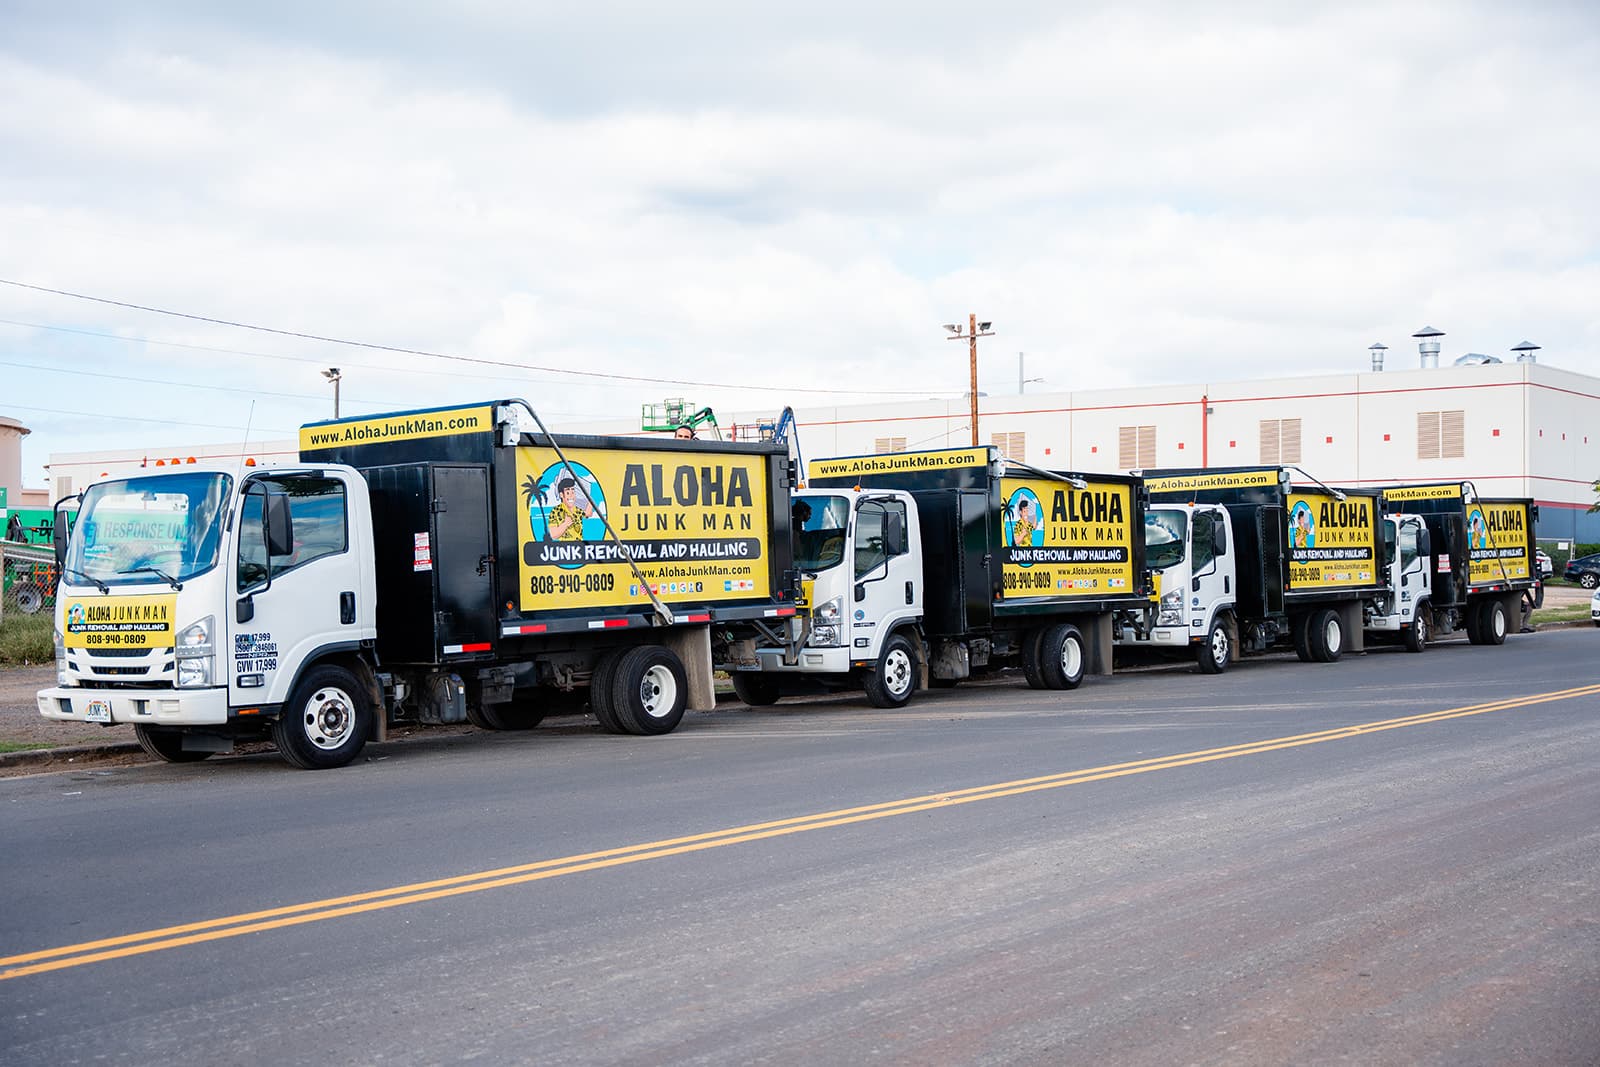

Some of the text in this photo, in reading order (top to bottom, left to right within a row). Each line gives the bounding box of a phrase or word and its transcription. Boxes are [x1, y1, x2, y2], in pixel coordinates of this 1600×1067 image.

[310, 415, 478, 445] www.AlohaJunkMan.com
[820, 452, 975, 474] www.AlohaJunkMan.com
[620, 463, 753, 507] ALOHA
[1051, 490, 1123, 523] ALOHA
[1319, 502, 1368, 528] ALOHA
[620, 513, 751, 531] JUNK MAN
[1489, 510, 1523, 531] ALOHA
[1051, 526, 1124, 541] JUNK MAN
[1319, 531, 1369, 542] JUNK MAN
[540, 541, 748, 562] JUNK REMOVAL AND HAULING
[1010, 549, 1122, 561] JUNK REMOVAL AND HAULING
[631, 565, 751, 579] www.AlohaJunkMan.com
[1003, 571, 1051, 590] 808-940-0809
[530, 573, 615, 595] 808-940-0809
[88, 606, 110, 621] ALOHA
[86, 634, 146, 644] 808-940-0809
[236, 658, 277, 672] GVW 17,999
